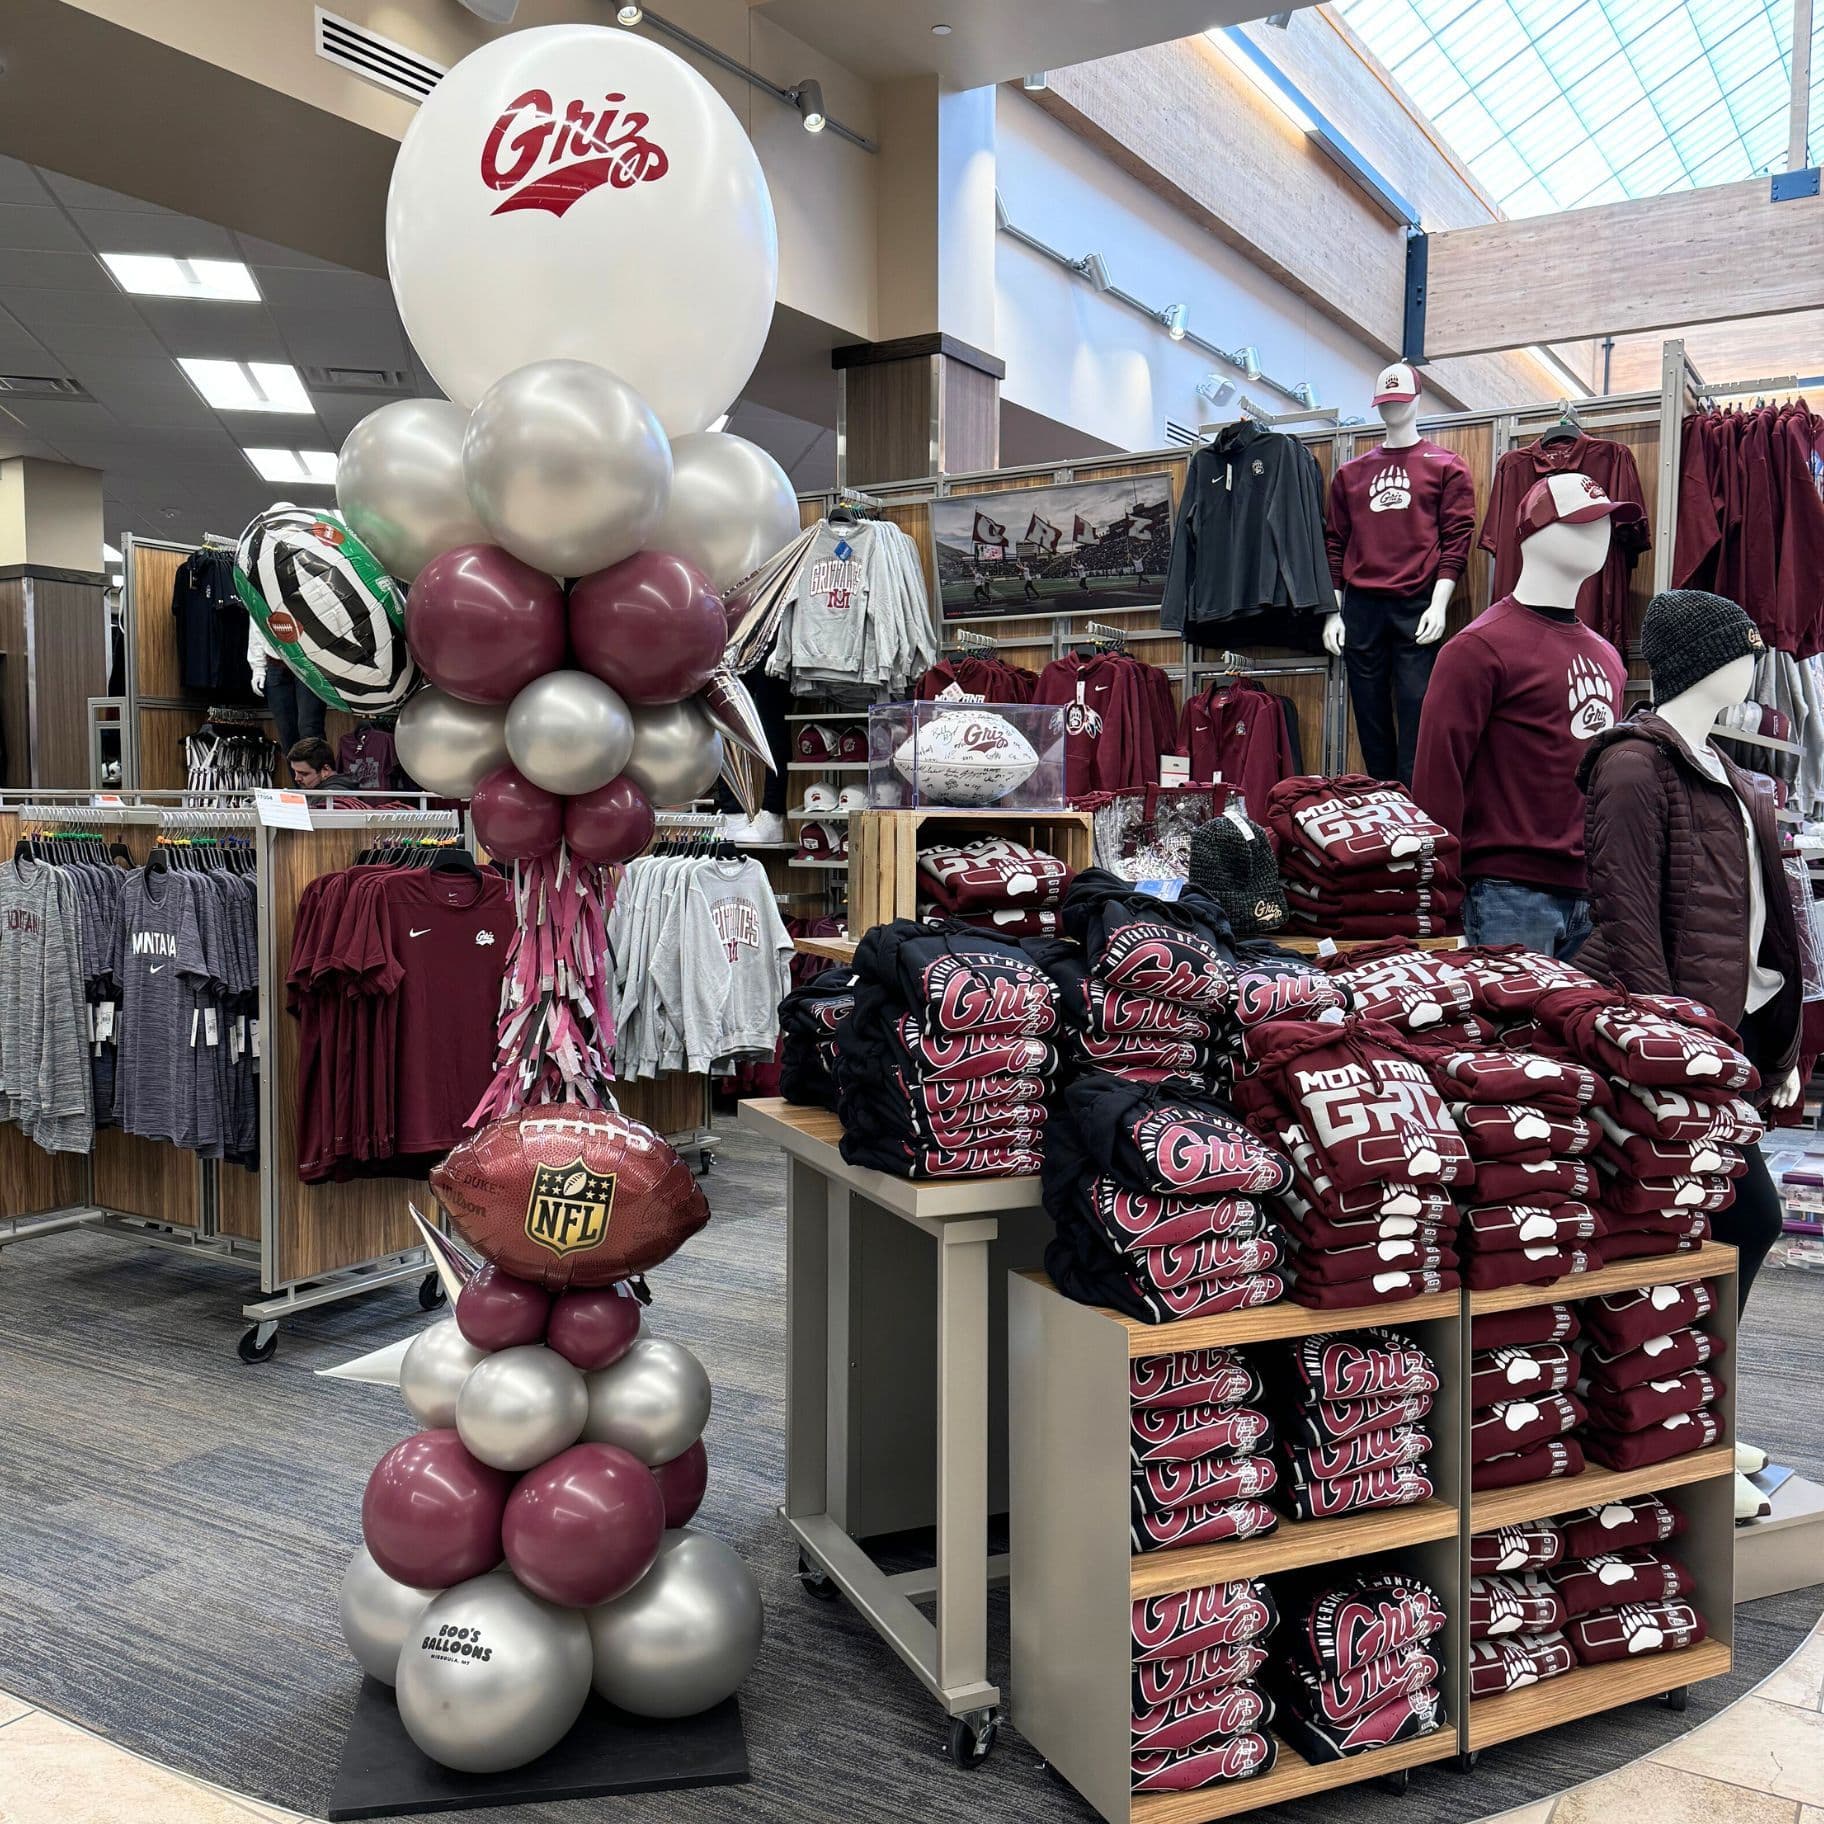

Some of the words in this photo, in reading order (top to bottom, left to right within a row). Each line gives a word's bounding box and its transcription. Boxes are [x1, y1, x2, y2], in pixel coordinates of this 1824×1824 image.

[481, 89, 669, 190] Griz
[963, 723, 1009, 750] Griz
[1294, 790, 1410, 827] MONTAN
[1254, 899, 1283, 921] Griz
[979, 955, 996, 965] OF
[1106, 926, 1170, 967] UNIVERSITY
[1176, 933, 1193, 945] OF
[1104, 943, 1230, 1000] Griz
[939, 970, 1057, 1034] Griz
[1235, 971, 1347, 1025] Griz
[1156, 1125, 1284, 1193] Griz
[534, 1198, 600, 1245] NFL
[1322, 1342, 1440, 1400] Griz
[421, 1636, 493, 1662] BALLOONS
[439, 1624, 482, 1643] BOO'S
[1336, 1588, 1447, 1672] Griz
